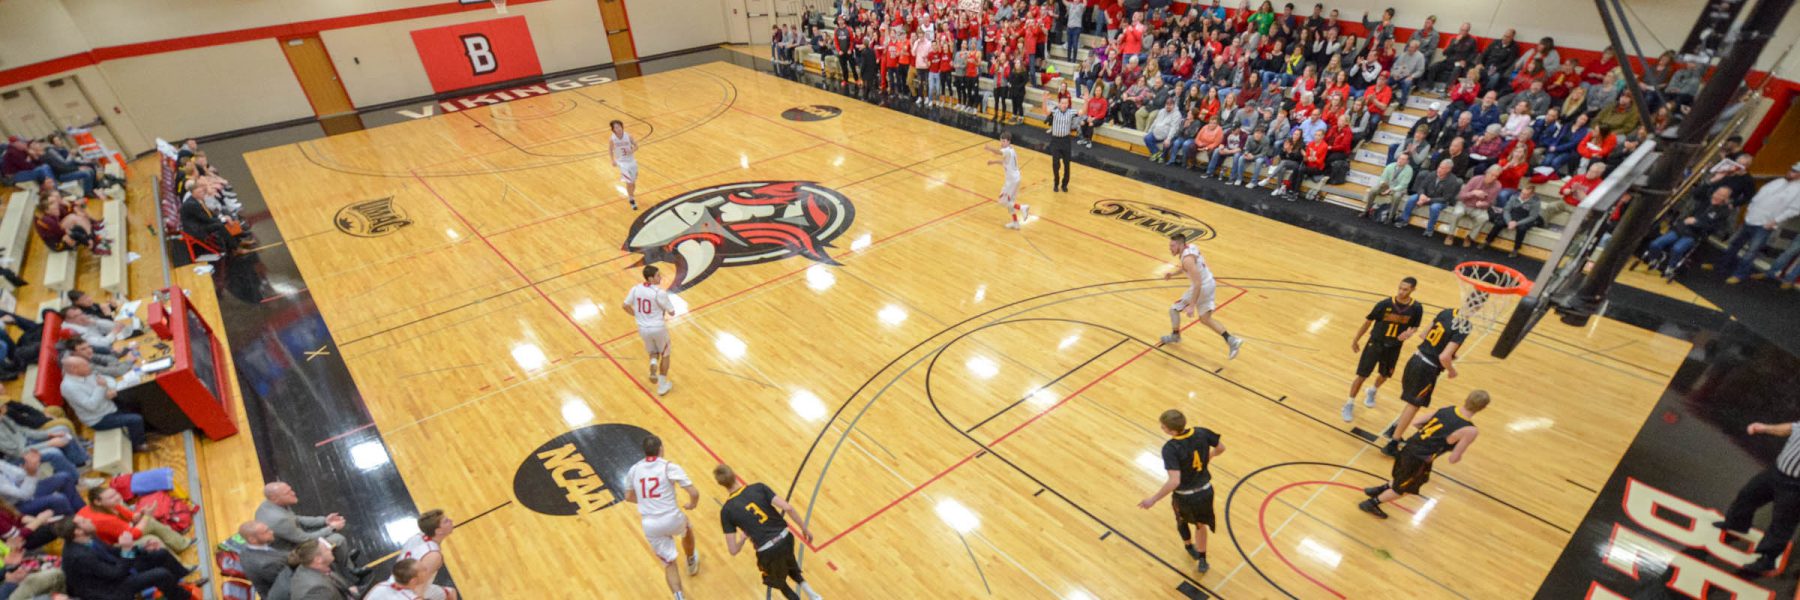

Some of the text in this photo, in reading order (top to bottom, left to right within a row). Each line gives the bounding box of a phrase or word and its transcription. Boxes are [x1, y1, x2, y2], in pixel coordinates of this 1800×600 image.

[460, 34, 498, 76] B
[396, 74, 613, 120] VIKINGS
[1091, 202, 1207, 243] UMAC
[637, 297, 652, 315] 10
[1385, 323, 1399, 338] 11
[1192, 449, 1203, 472] 4
[536, 442, 616, 516] NCAA
[639, 477, 662, 499] 12
[744, 502, 769, 525] 3
